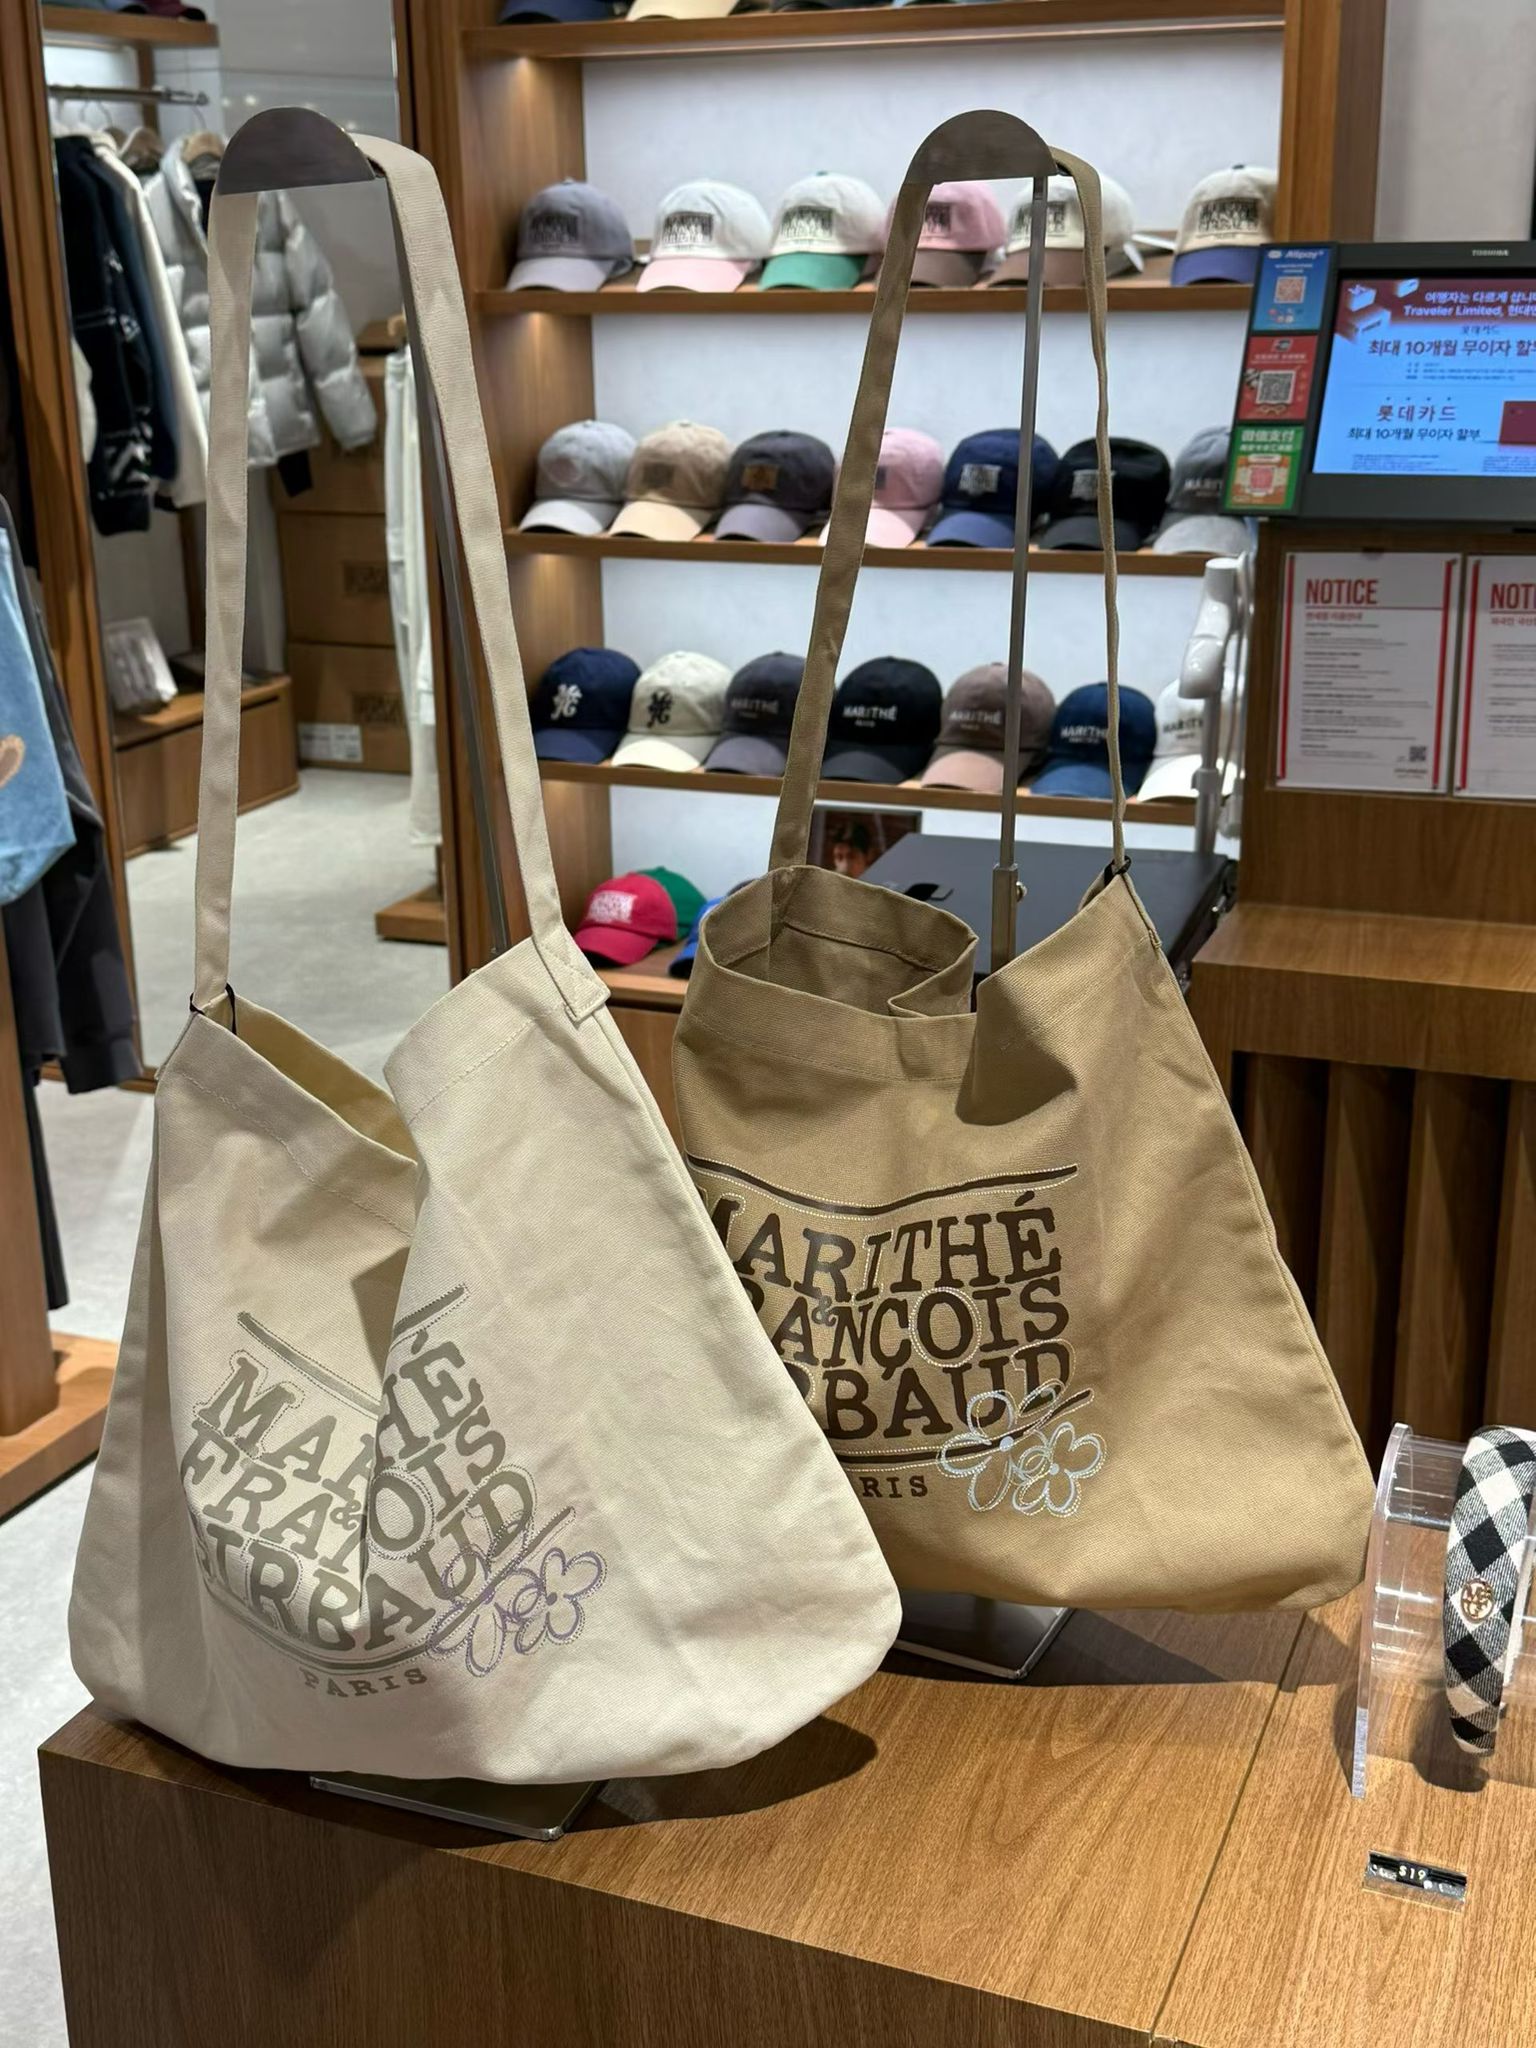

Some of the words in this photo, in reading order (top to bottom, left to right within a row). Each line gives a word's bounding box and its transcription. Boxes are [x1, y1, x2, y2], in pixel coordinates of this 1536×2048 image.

[1472, 249, 1509, 257] TOSHIBA
[1403, 304, 1453, 317] Traveler
[1369, 339, 1401, 356] 최대
[1406, 339, 1458, 357] 10개월
[1461, 339, 1512, 357] 무이자
[1348, 427, 1372, 440] 최대
[1376, 428, 1414, 441] 10개월
[1417, 428, 1453, 441] 무이자
[1457, 428, 1480, 441] 할부
[1305, 578, 1378, 605] NOTICE
[812, 1295, 837, 1325] &
[740, 1276, 1070, 1379] ANÇOIS
[859, 1475, 928, 1498] RIS
[299, 1667, 427, 1698] PARIS
